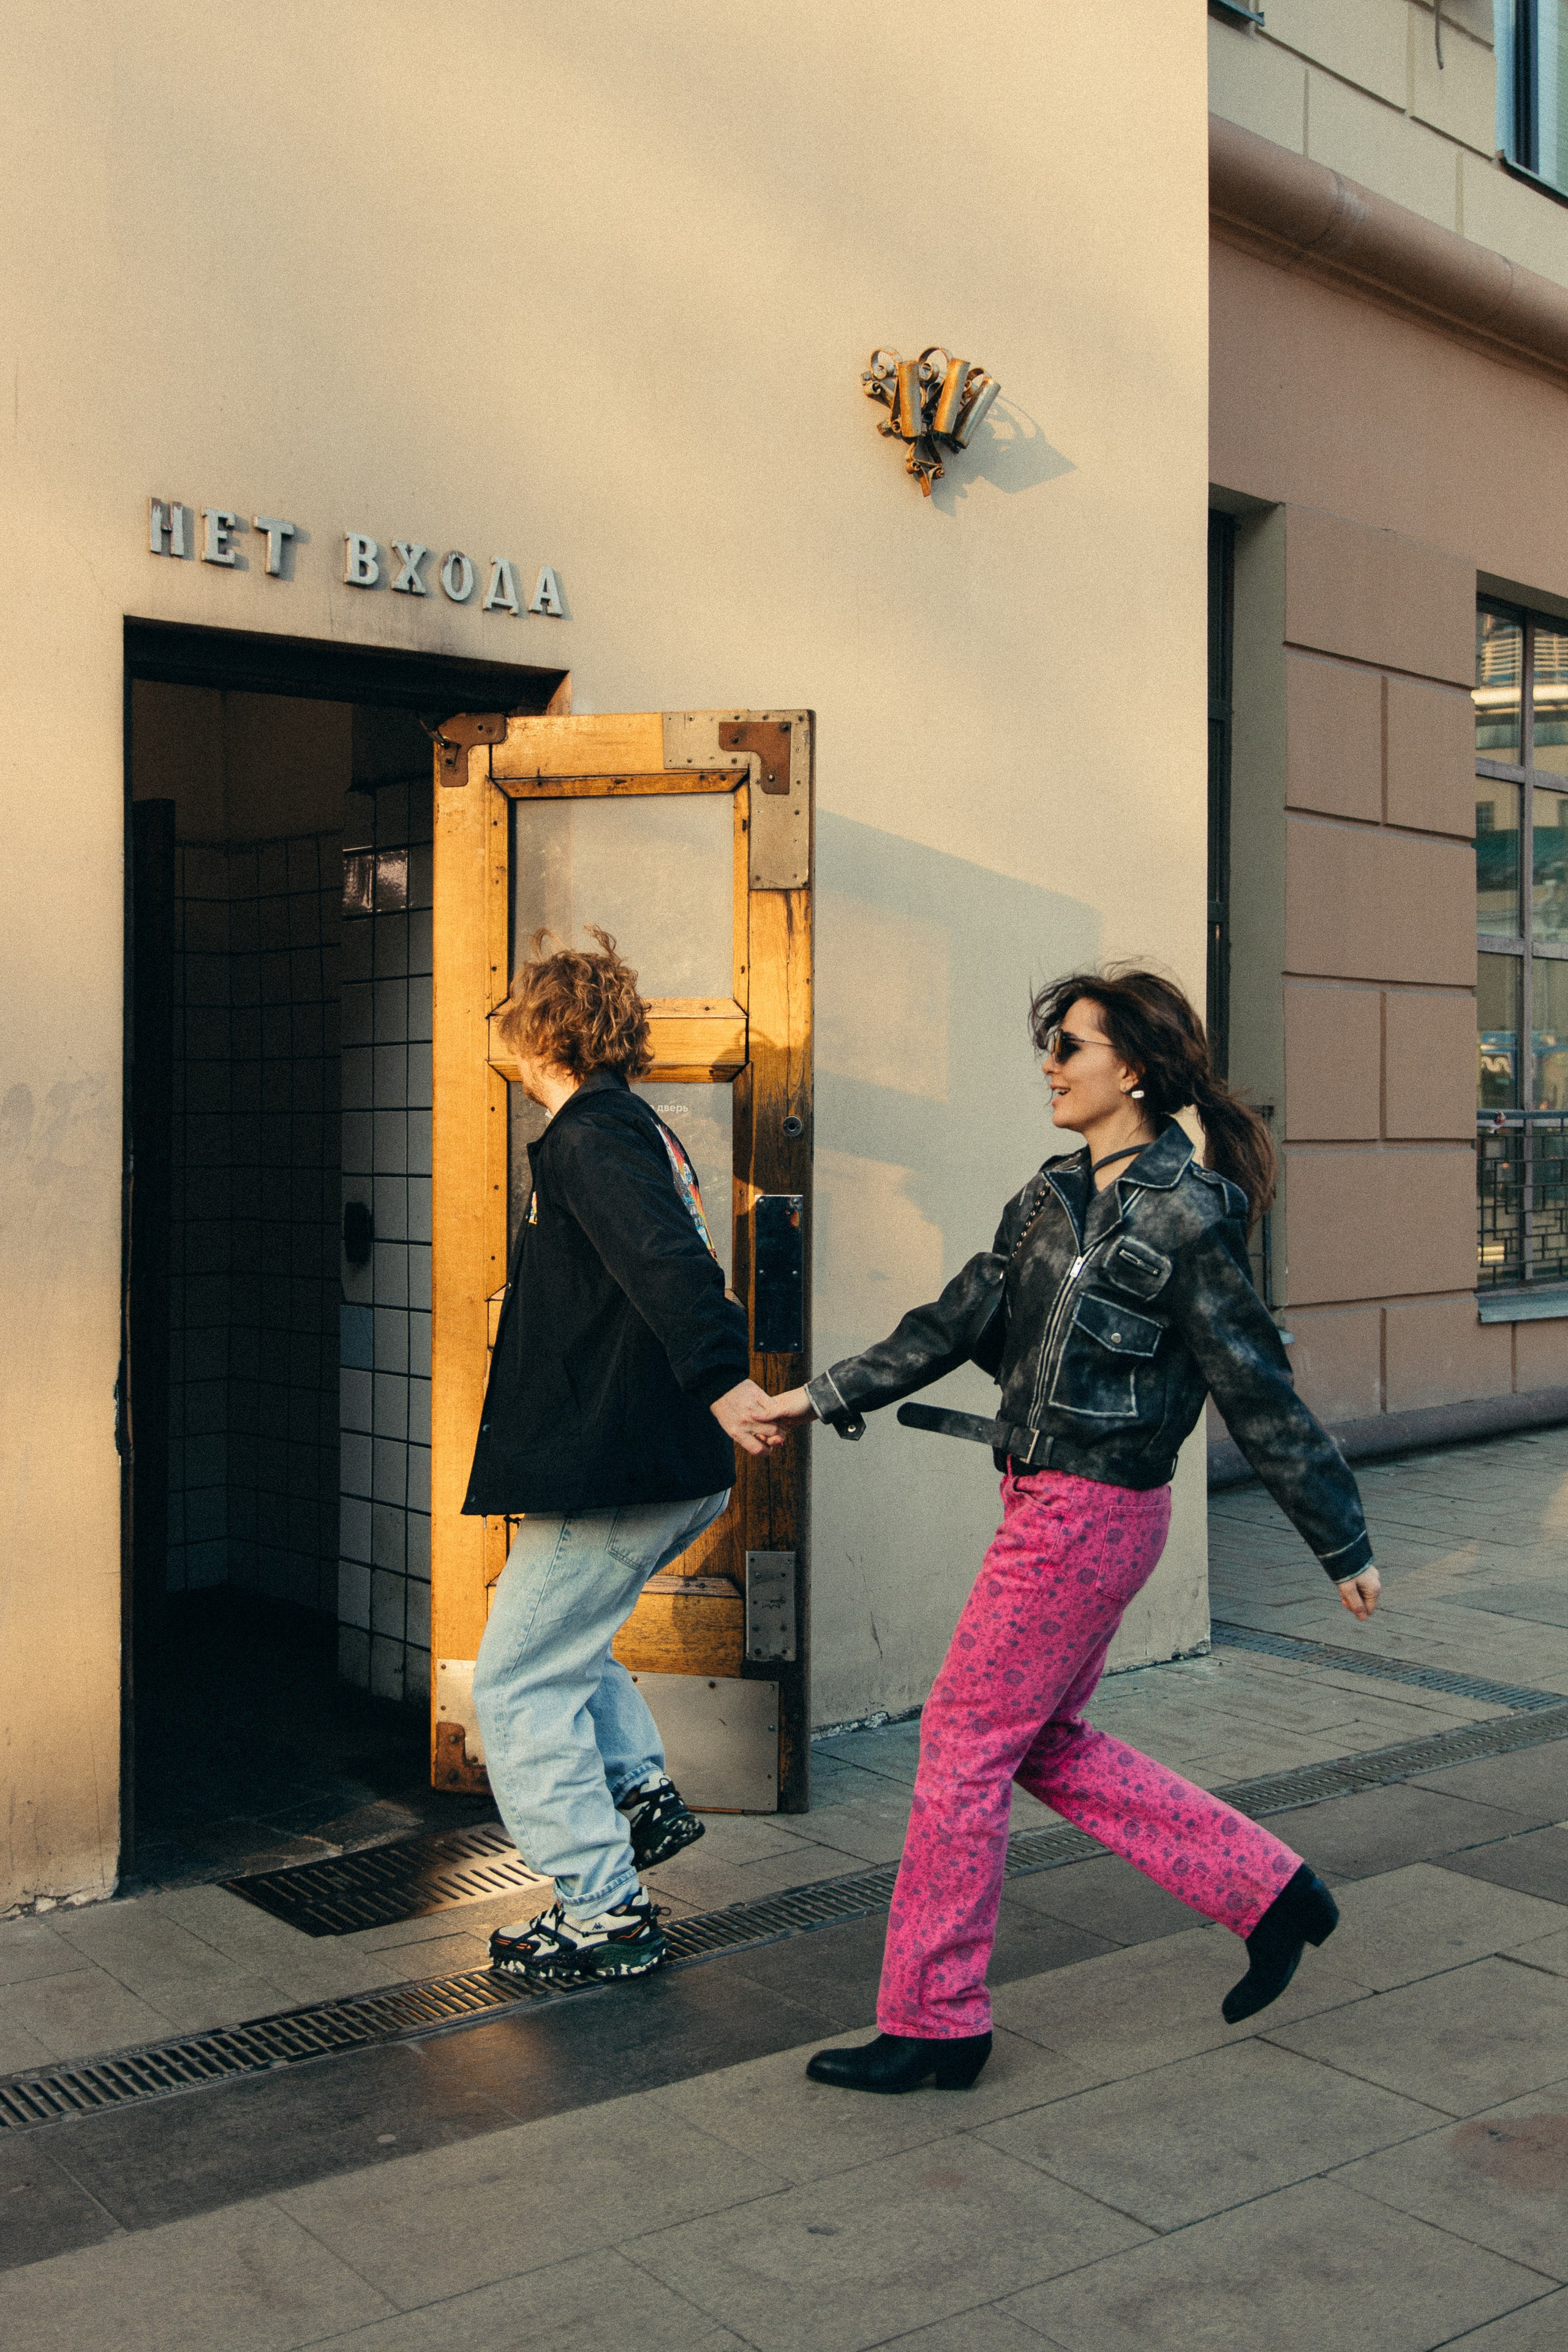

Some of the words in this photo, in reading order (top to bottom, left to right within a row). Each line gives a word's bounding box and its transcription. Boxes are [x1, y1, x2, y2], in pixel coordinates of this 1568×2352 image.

[149, 497, 295, 576] НЕТ
[344, 532, 562, 616] ВХОДА
[657, 1104, 689, 1114] дверь
